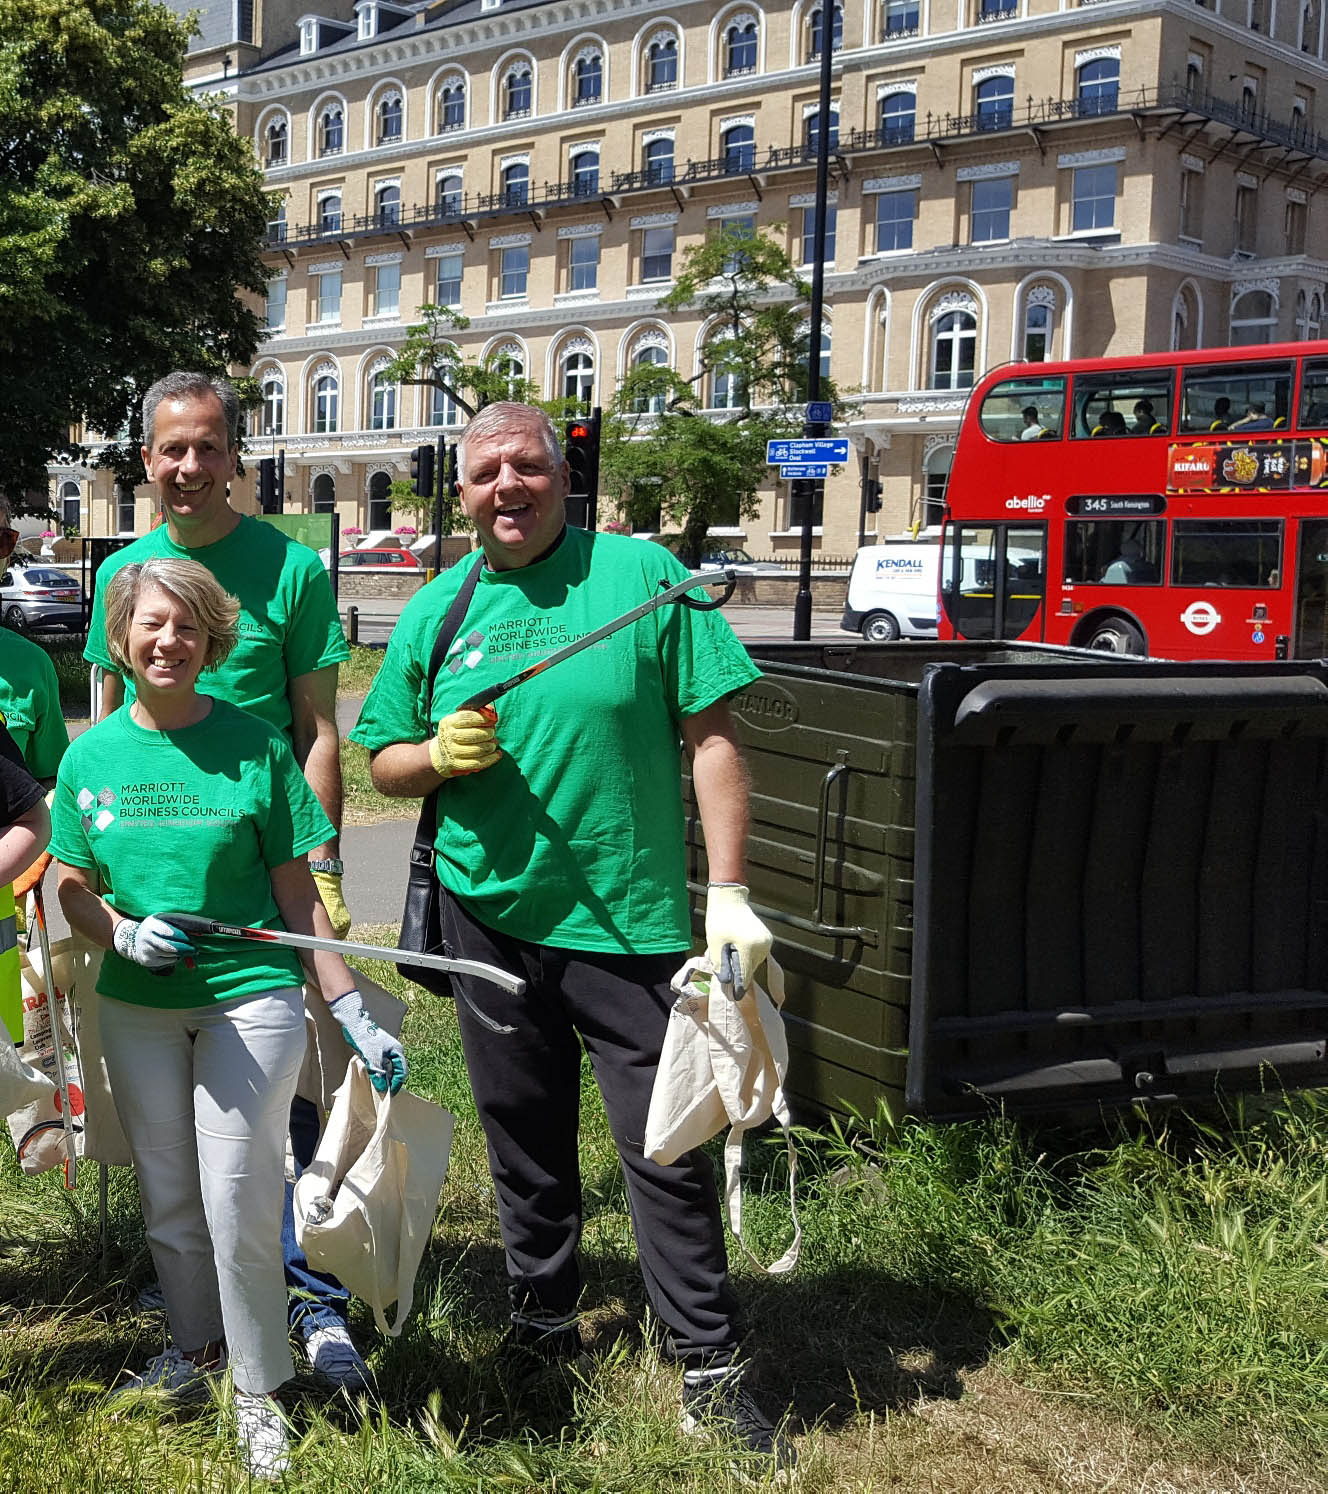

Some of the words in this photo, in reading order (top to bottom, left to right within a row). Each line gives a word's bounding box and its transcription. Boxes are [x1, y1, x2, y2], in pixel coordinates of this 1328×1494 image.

[1005, 495, 1045, 509] abellio
[1084, 499, 1108, 511] 345
[876, 559, 923, 571] KENDALL
[488, 616, 553, 632] MARRIOTT
[488, 624, 568, 643] WORLDWIDE
[488, 638, 547, 655] BUSINESS
[736, 693, 793, 720] TAYLOR
[121, 782, 186, 795] MARRIOTT
[120, 794, 200, 805] WORLDWIDE
[119, 806, 179, 818] BUSINESS
[181, 807, 246, 818] COUNCILS
